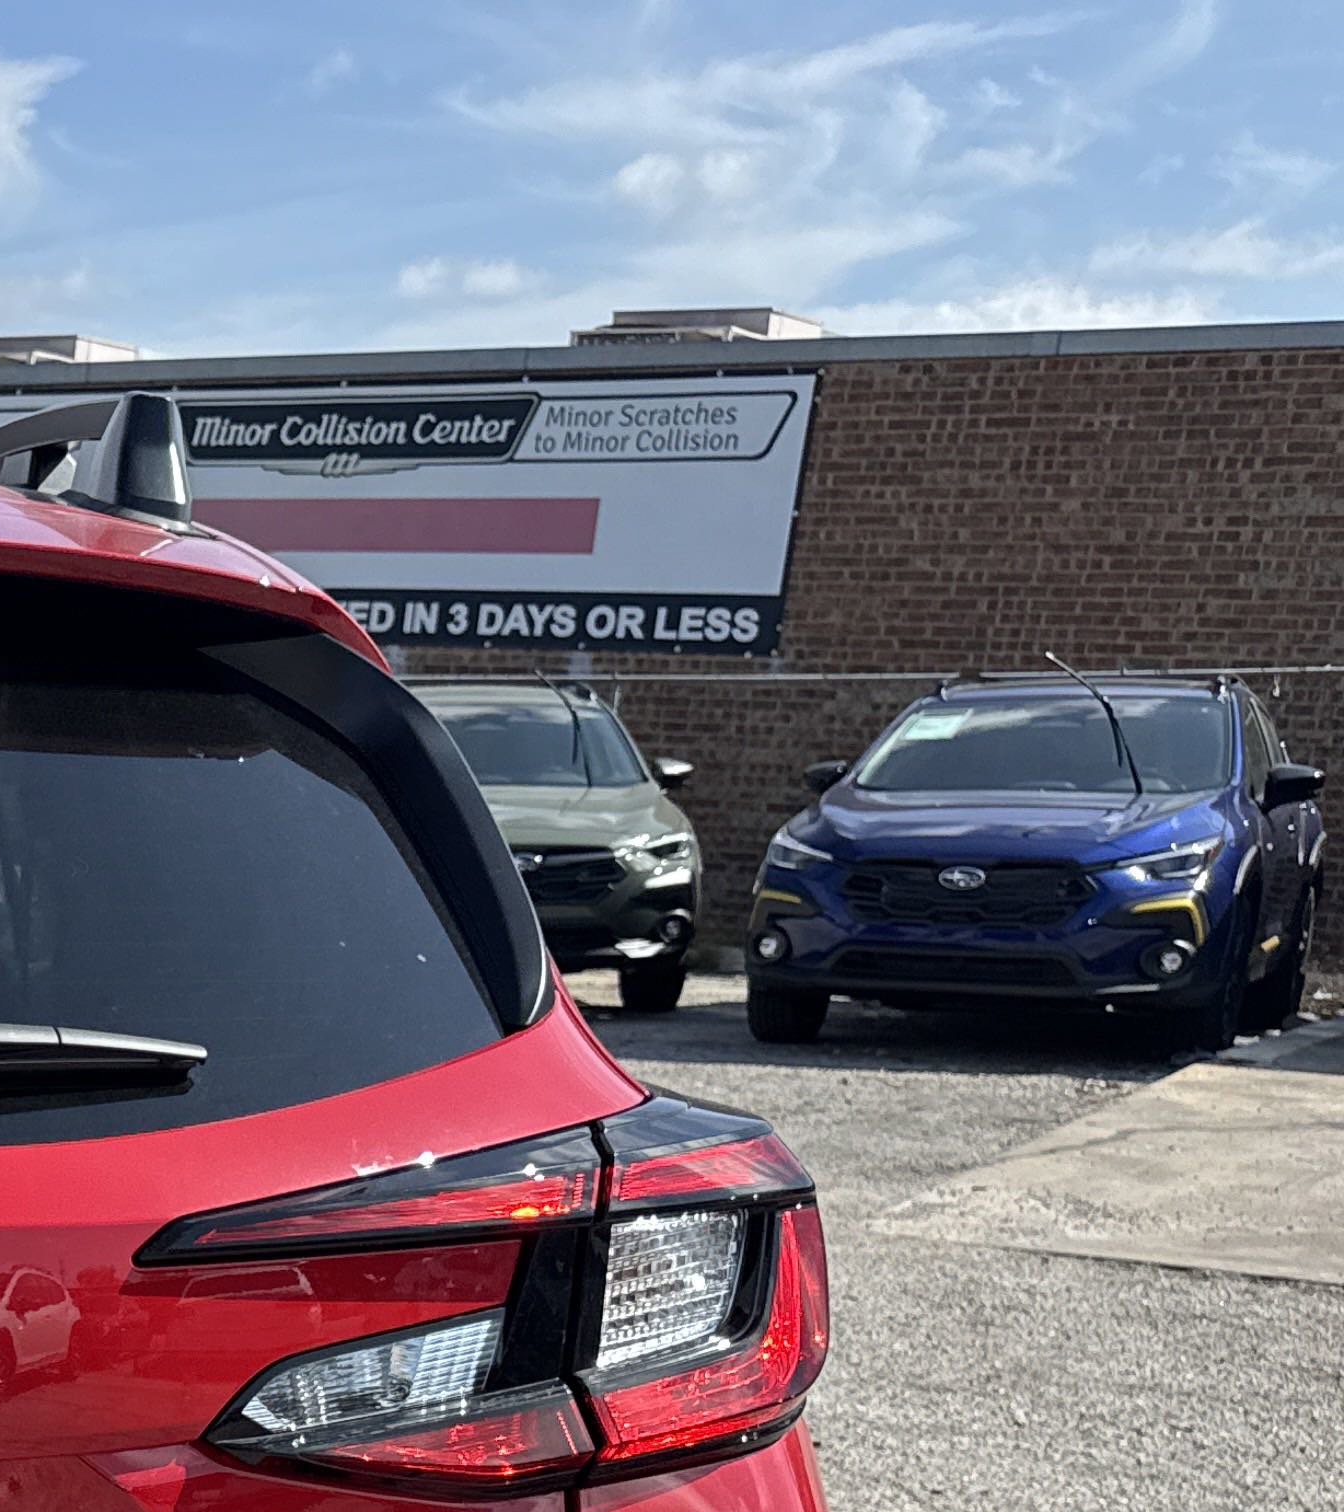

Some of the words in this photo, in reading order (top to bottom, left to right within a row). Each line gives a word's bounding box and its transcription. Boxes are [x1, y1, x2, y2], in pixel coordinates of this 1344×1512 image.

[192, 416, 277, 446] Minor
[280, 414, 407, 446] Collision
[412, 413, 516, 445] Center
[545, 405, 613, 428] Minor
[618, 402, 737, 427] Scratches
[534, 433, 556, 454] to
[563, 432, 630, 453] Minor
[636, 428, 739, 452] Collision
[402, 602, 439, 635] IN
[446, 602, 469, 636] 3
[476, 603, 577, 639] DAYS
[585, 604, 645, 640] OR
[653, 606, 760, 643] LESS
